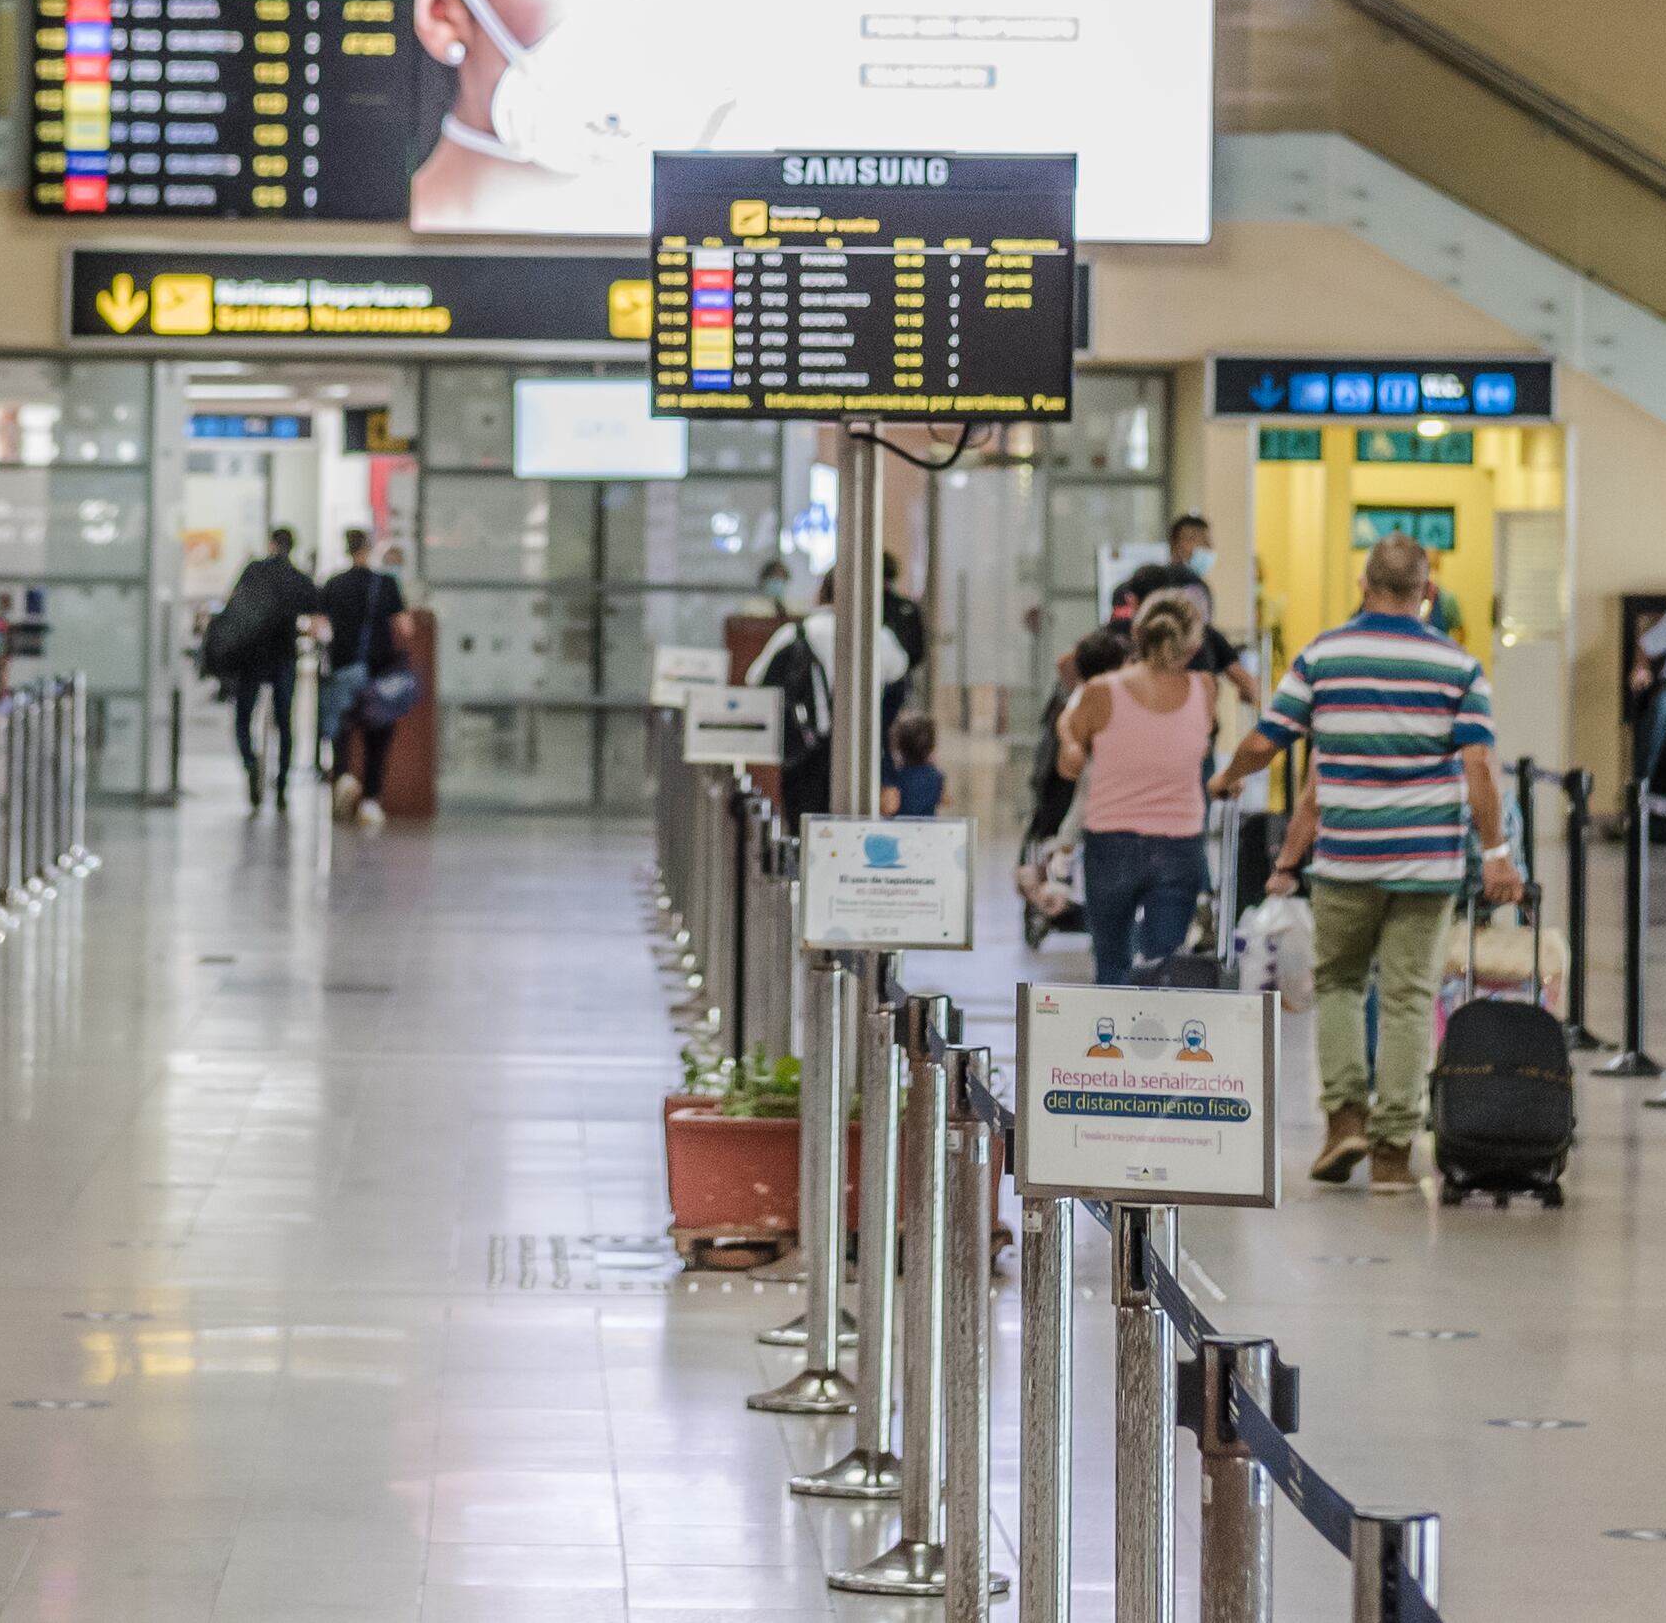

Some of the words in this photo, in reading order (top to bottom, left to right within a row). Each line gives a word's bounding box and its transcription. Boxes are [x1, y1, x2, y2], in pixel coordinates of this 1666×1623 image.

[782, 157, 949, 186] SAMSUNG
[1051, 1067, 1118, 1088] Respeta
[1123, 1070, 1136, 1088] la
[1140, 1071, 1245, 1093] señalización
[1046, 1093, 1072, 1110] del
[1076, 1094, 1205, 1116] distanciamiento
